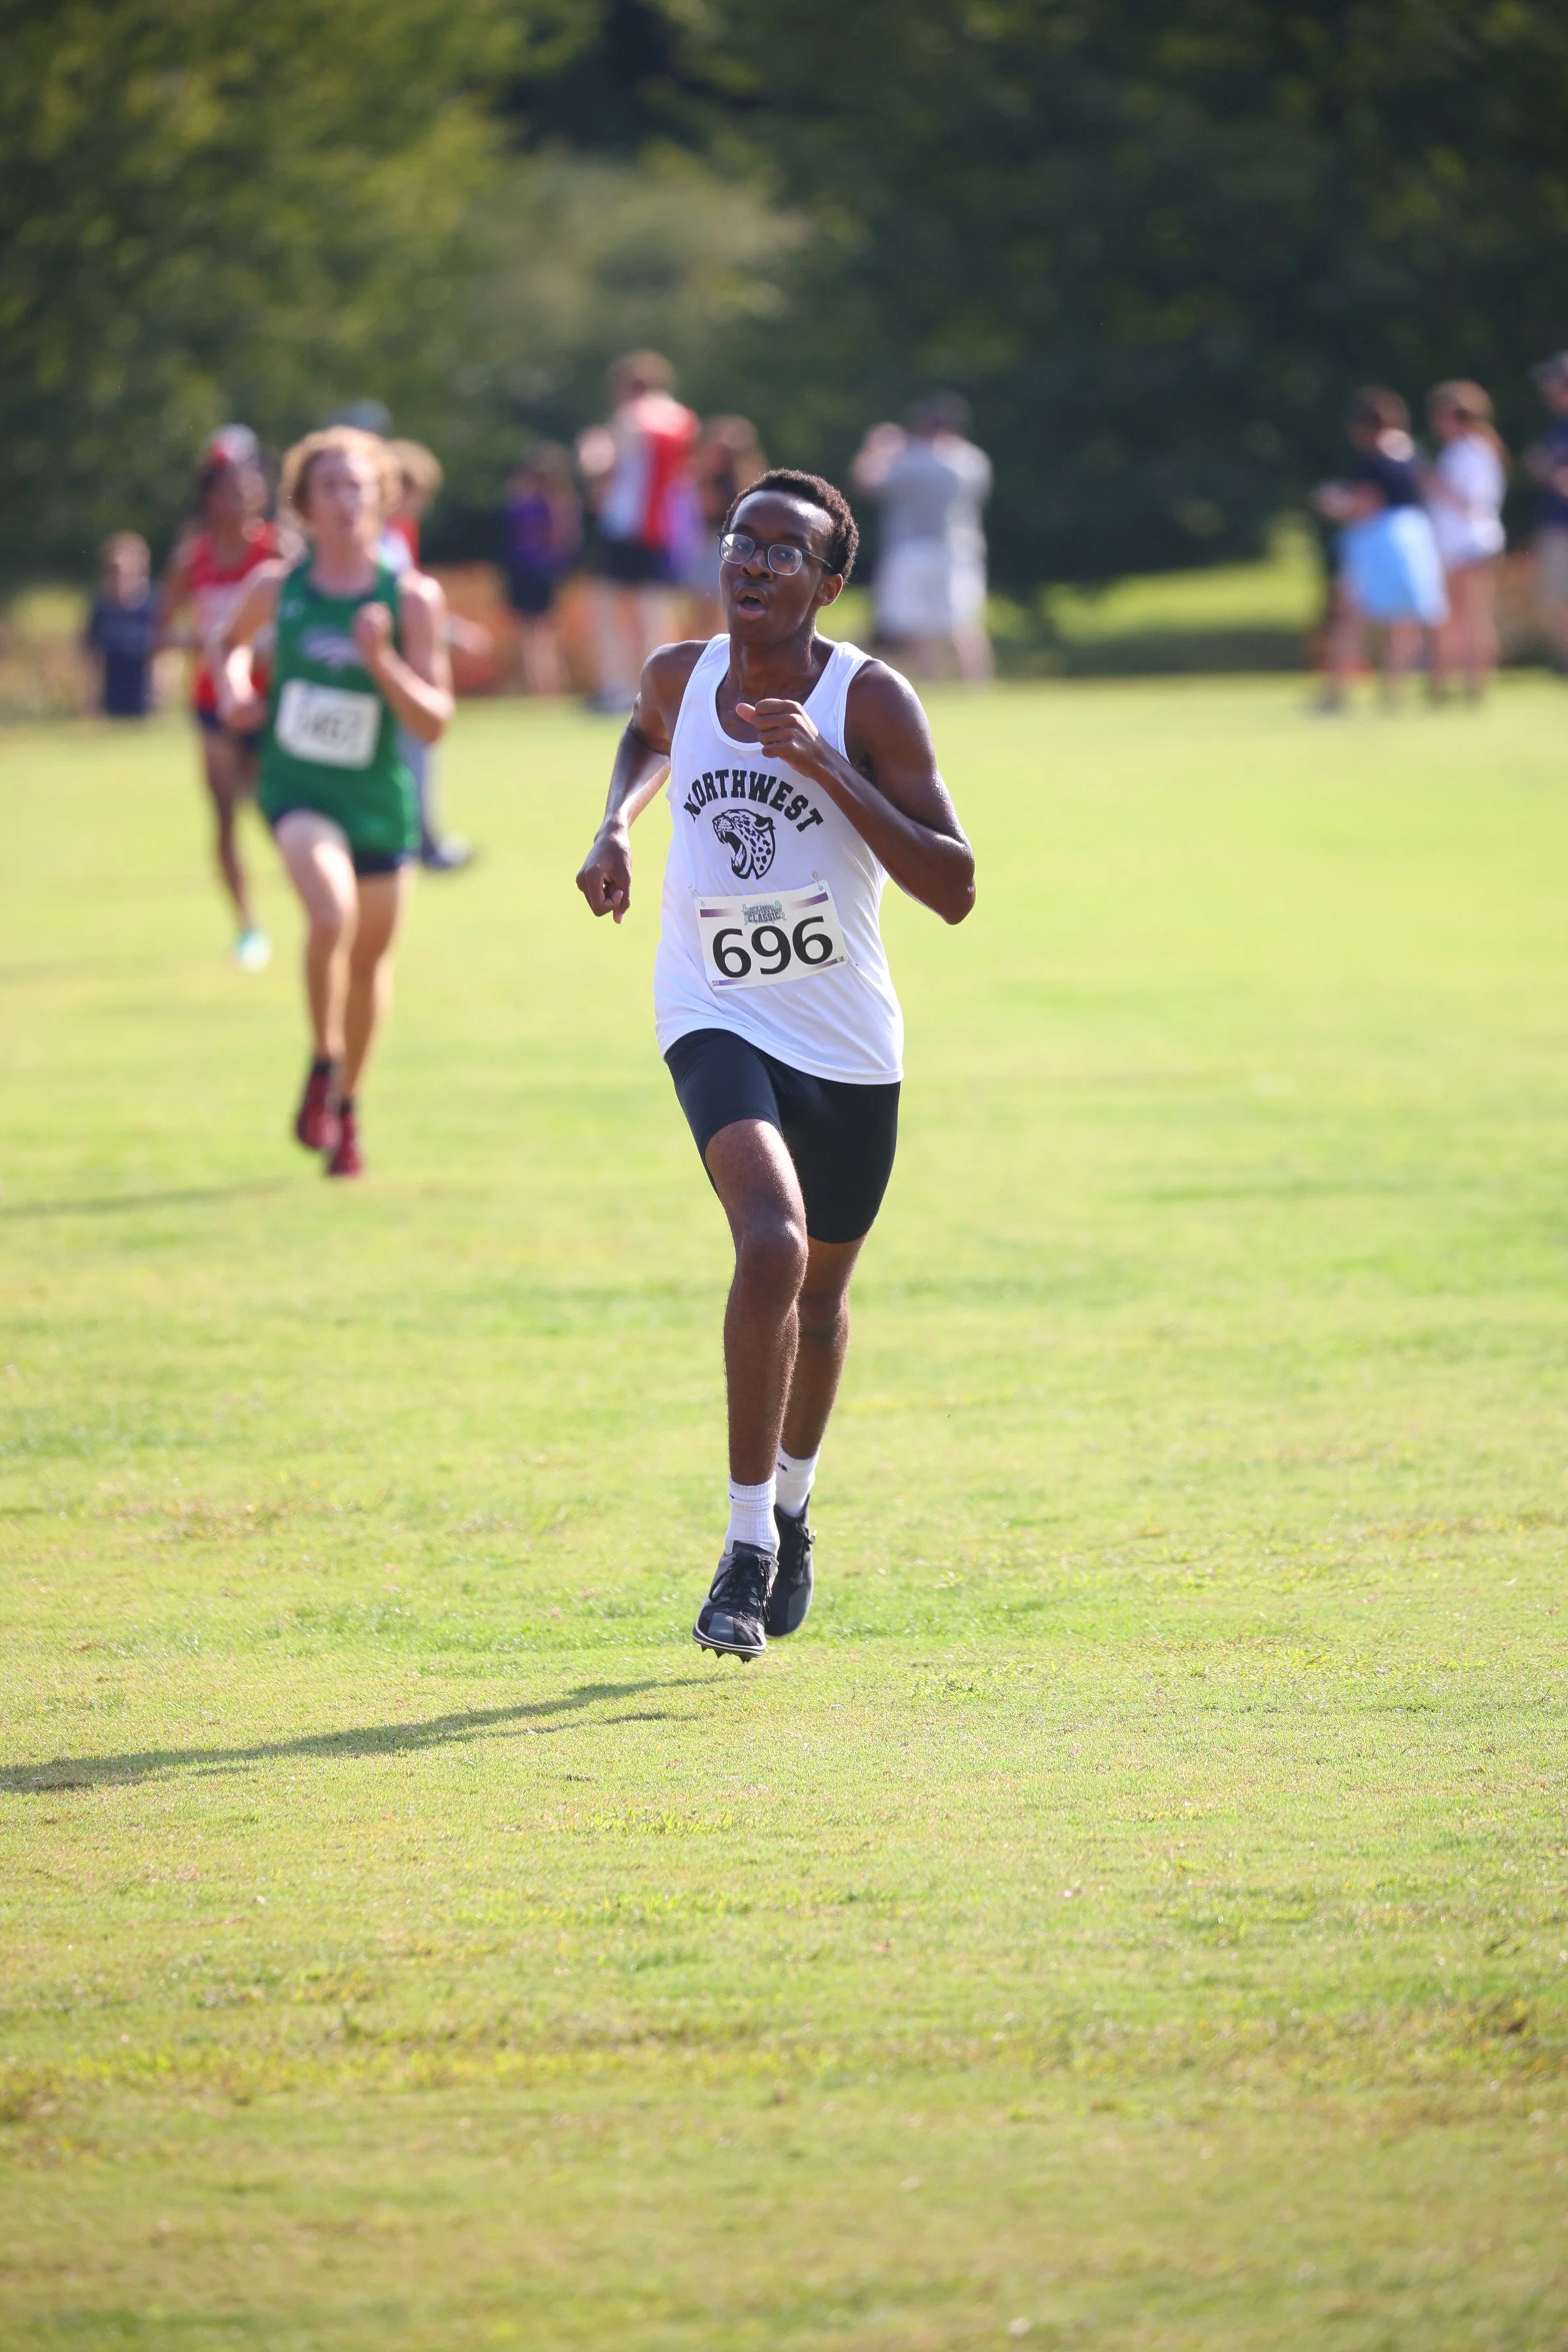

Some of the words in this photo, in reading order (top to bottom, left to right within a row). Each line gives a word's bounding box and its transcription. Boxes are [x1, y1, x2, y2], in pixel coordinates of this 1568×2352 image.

[683, 769, 824, 832] NORTHWEST
[713, 916, 833, 978] 696
[747, 912, 781, 923] CLASSIC
